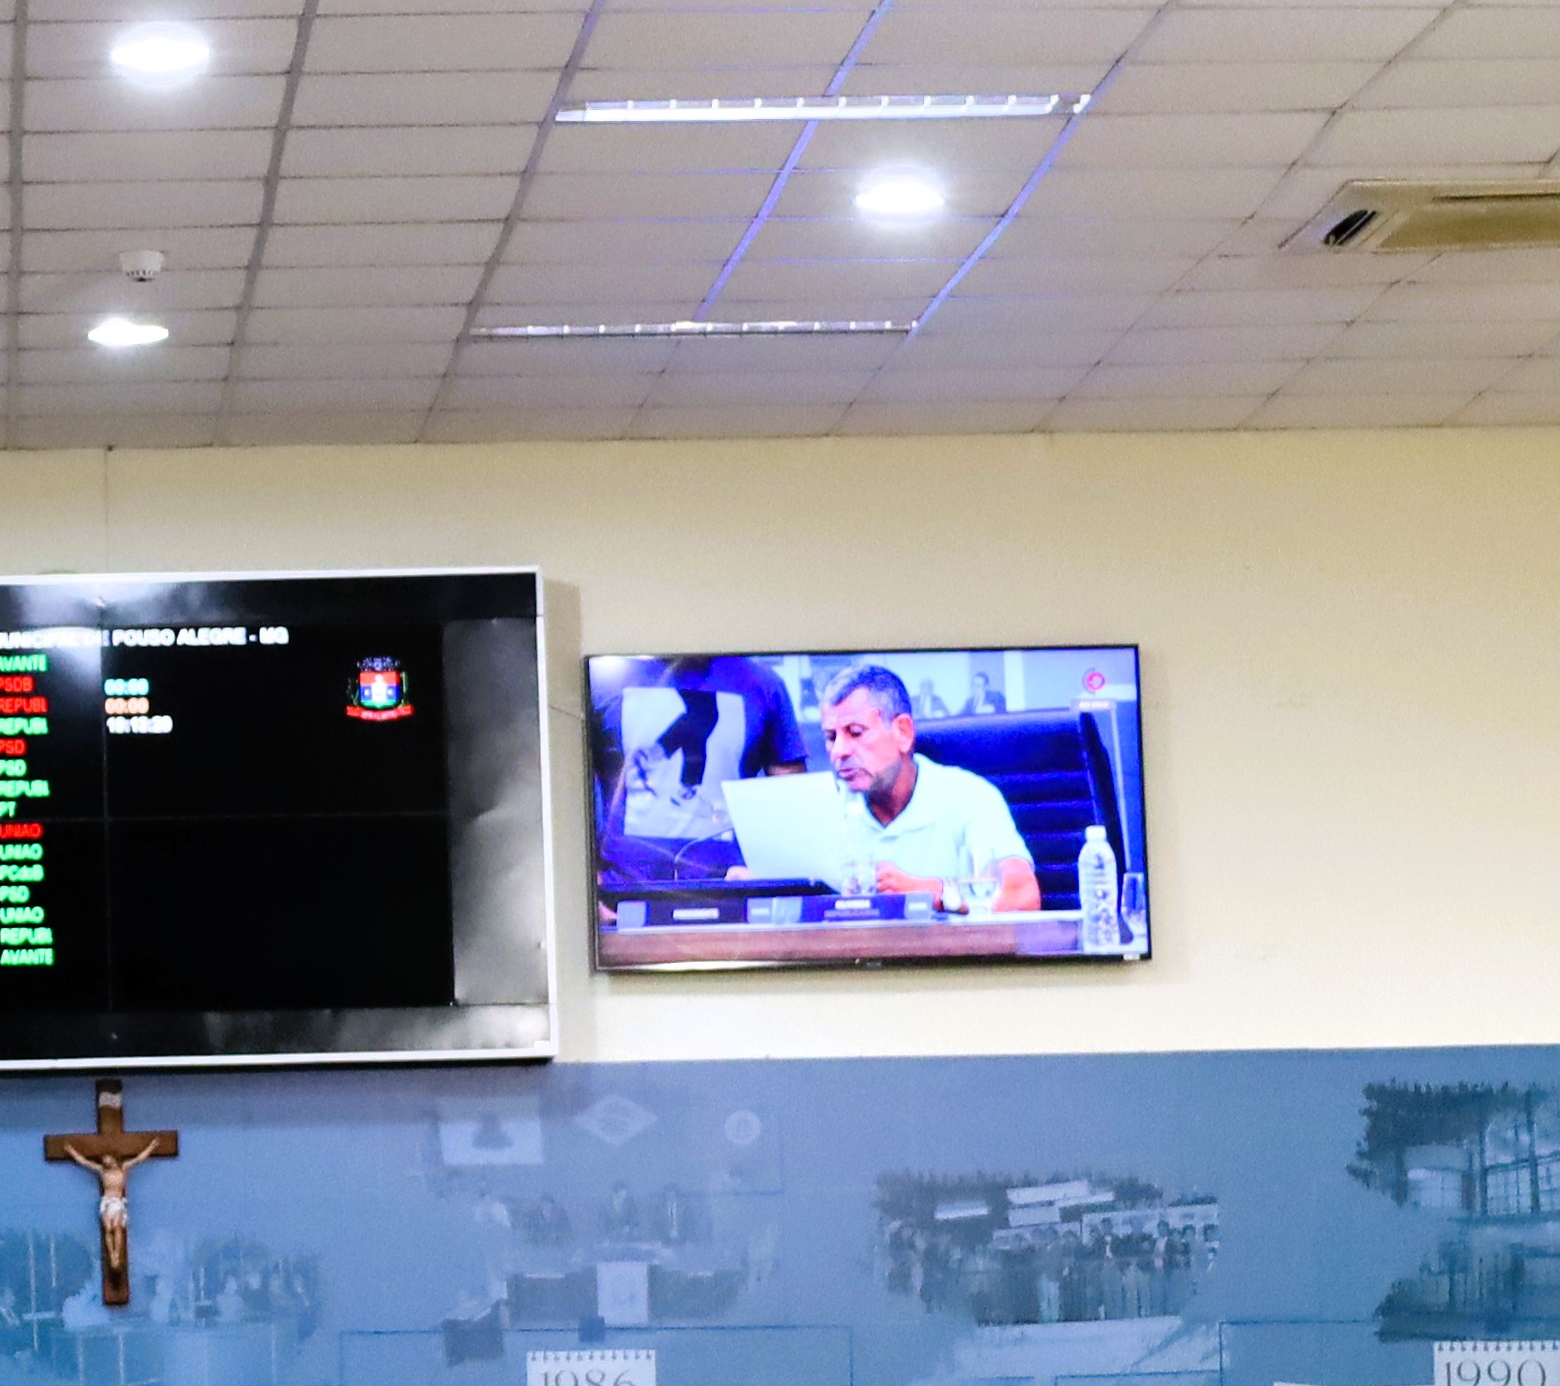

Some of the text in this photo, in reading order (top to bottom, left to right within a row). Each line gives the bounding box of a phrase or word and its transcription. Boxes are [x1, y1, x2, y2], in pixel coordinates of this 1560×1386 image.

[112, 628, 175, 647] POUSO
[177, 627, 247, 646] ALEGRE
[260, 626, 289, 645] MG
